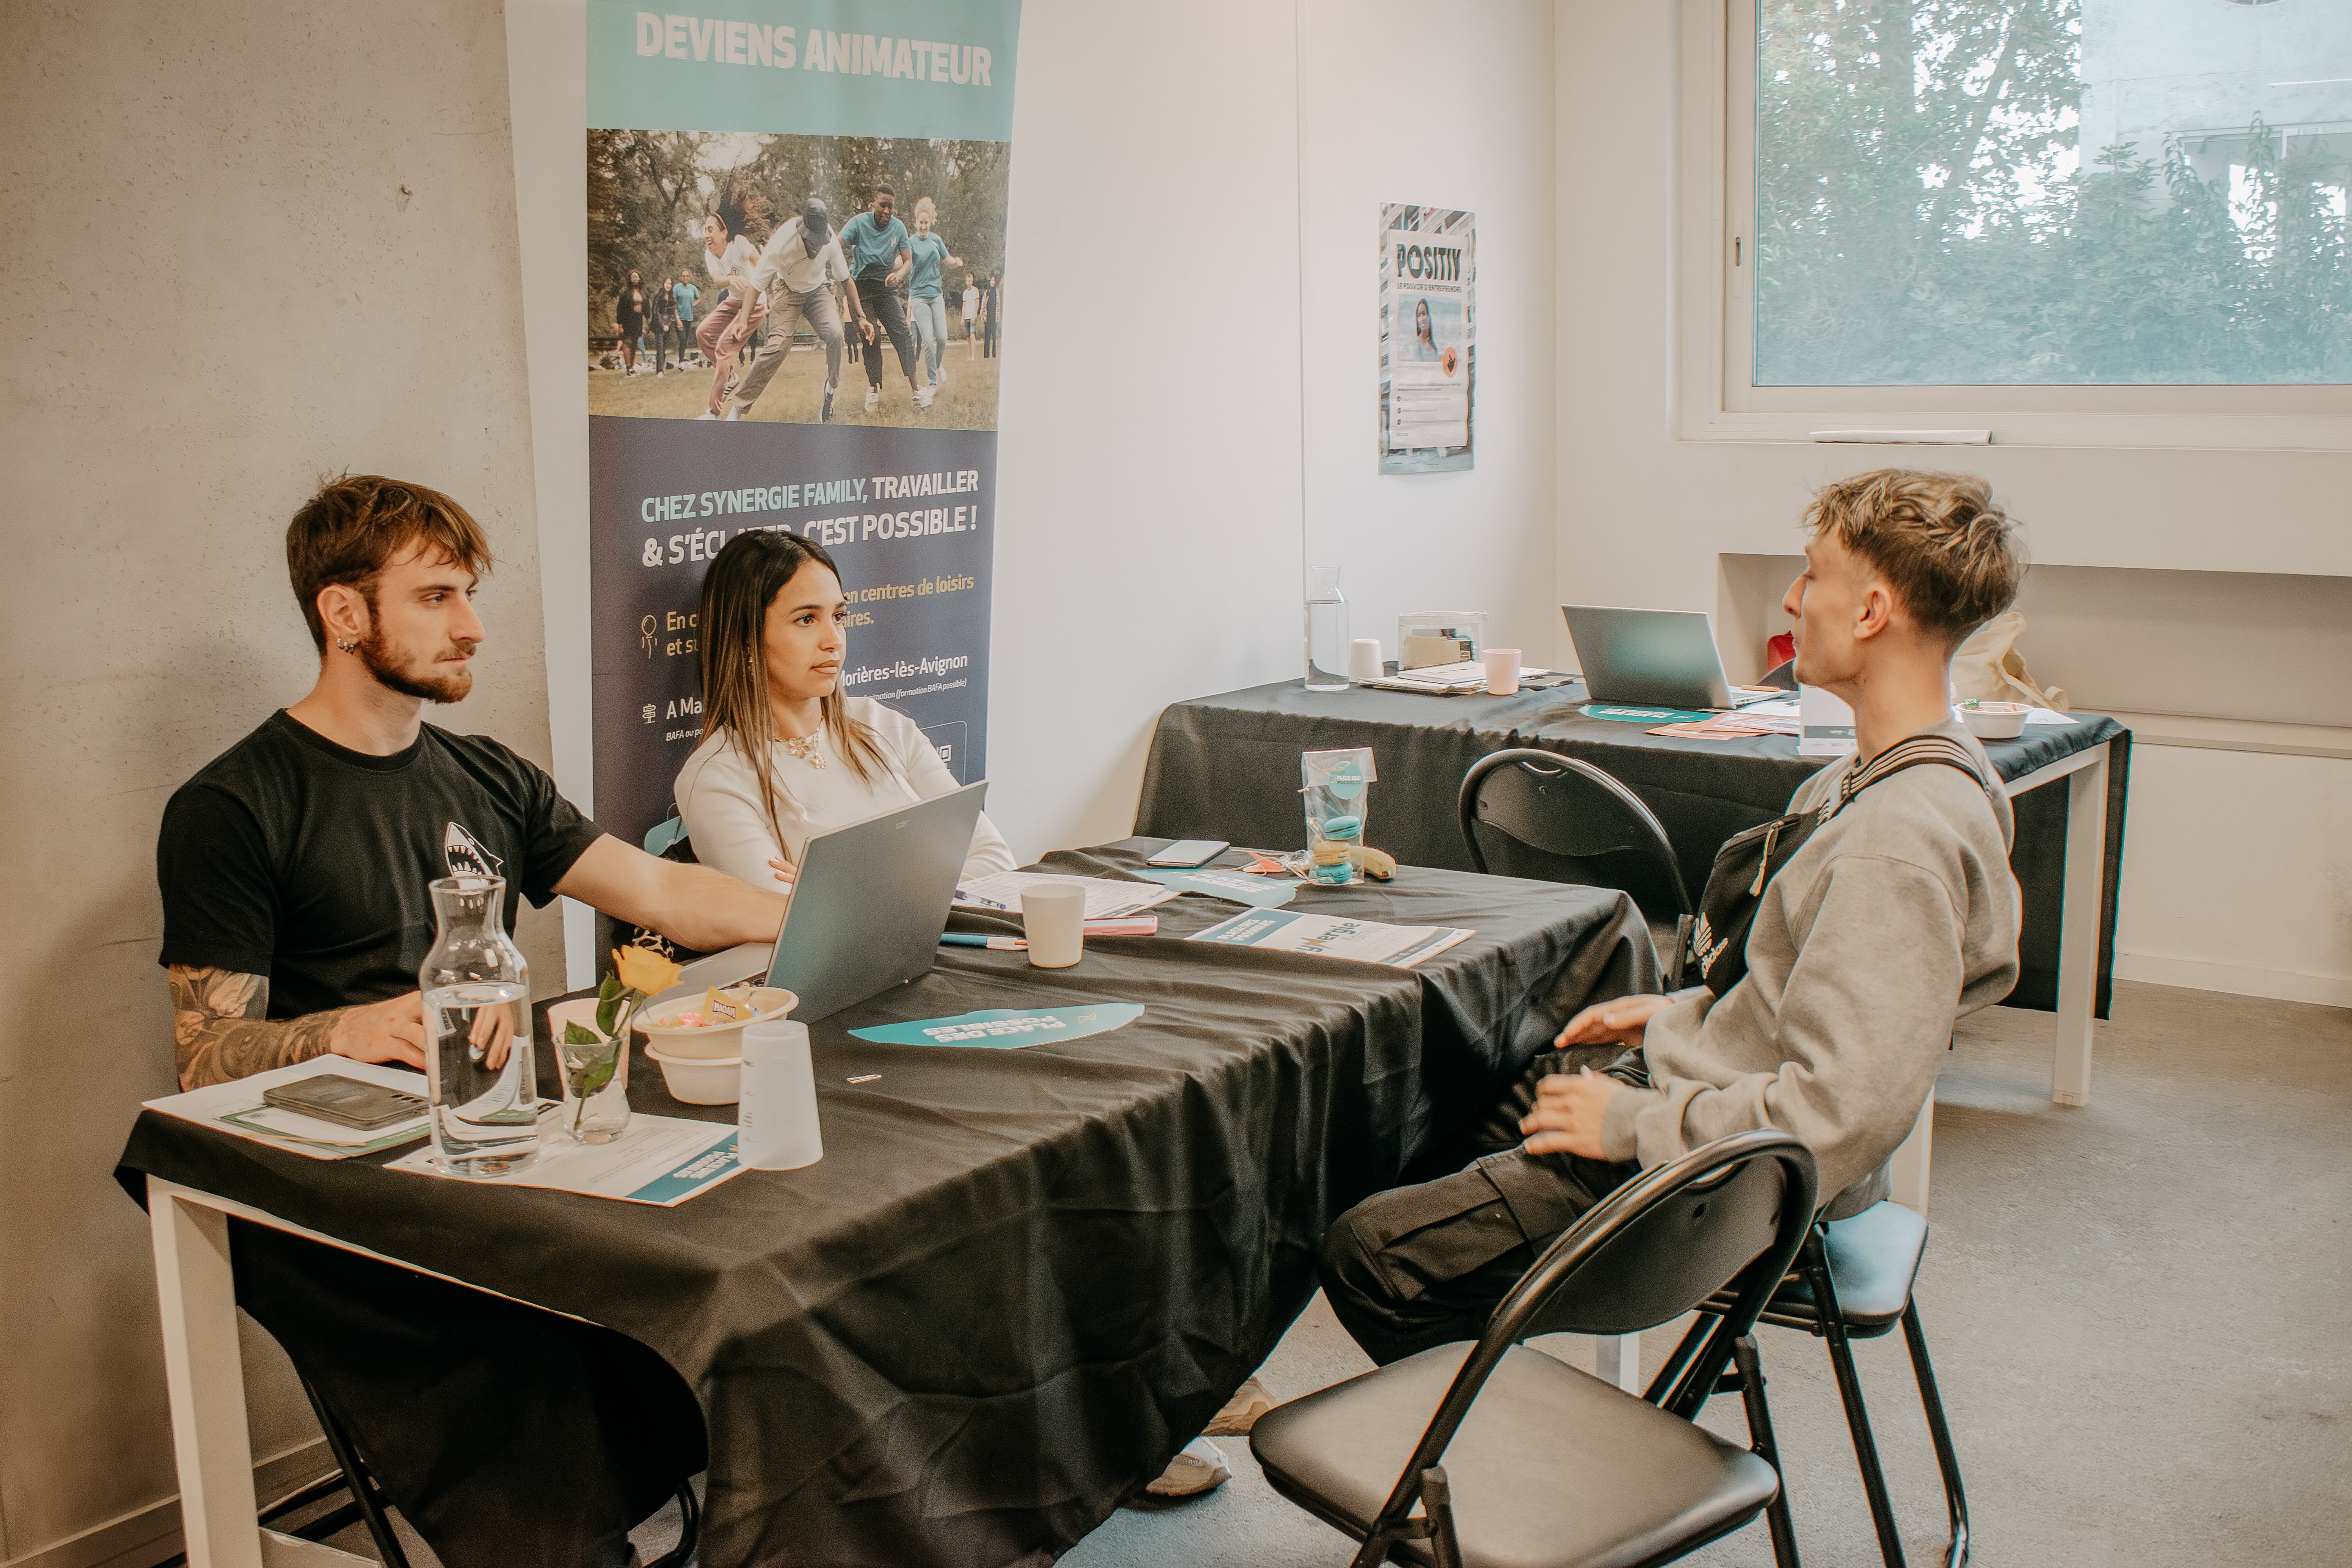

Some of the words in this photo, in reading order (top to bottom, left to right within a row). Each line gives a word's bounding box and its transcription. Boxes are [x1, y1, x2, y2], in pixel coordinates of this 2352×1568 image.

[636, 11, 797, 69] DEVIENS
[802, 29, 993, 86] ANIMATEUR
[1424, 284, 1462, 292] D'ENTREPRENDRE
[641, 494, 696, 522] CHEZ
[700, 485, 800, 517] SYNERGIE
[804, 478, 868, 506] FAMILY,
[872, 470, 979, 499] TRAVAILLER
[642, 538, 663, 567] &
[862, 506, 967, 541] POSSIBLE
[971, 505, 977, 530] !
[861, 584, 915, 602] centres
[917, 578, 933, 596] de
[936, 573, 974, 593] loisirs
[667, 611, 686, 632] En
[667, 638, 682, 656] et
[895, 687, 927, 699] (formation
[927, 682, 943, 693] BAFA
[942, 678, 967, 692] possible)
[666, 700, 677, 720] A
[666, 730, 684, 742] BAFA
[922, 1016, 1058, 1036] POSSIBLES
[934, 1029, 987, 1043] DES
[987, 1020, 1067, 1036] PLACE
